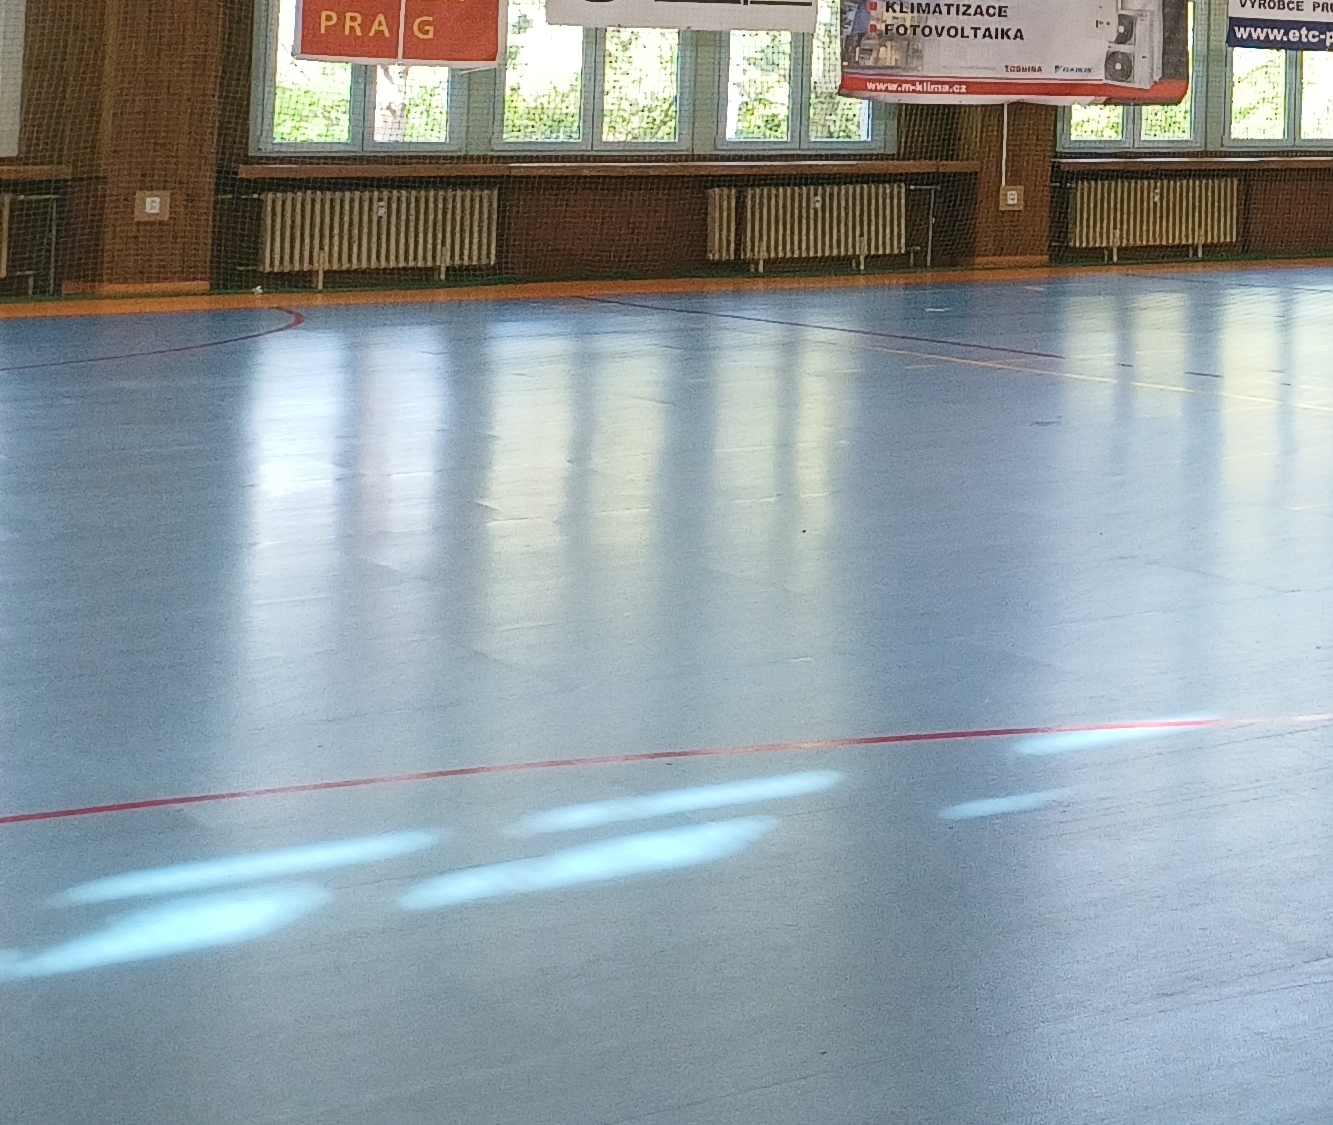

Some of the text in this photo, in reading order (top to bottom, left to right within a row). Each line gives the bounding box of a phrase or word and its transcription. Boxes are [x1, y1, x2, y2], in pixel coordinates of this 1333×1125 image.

[885, 0, 1009, 18] KLIMATIZACE
[884, 24, 1025, 41] FOTOVOLTAIKA
[866, 80, 968, 93] www.m-klima.cz
